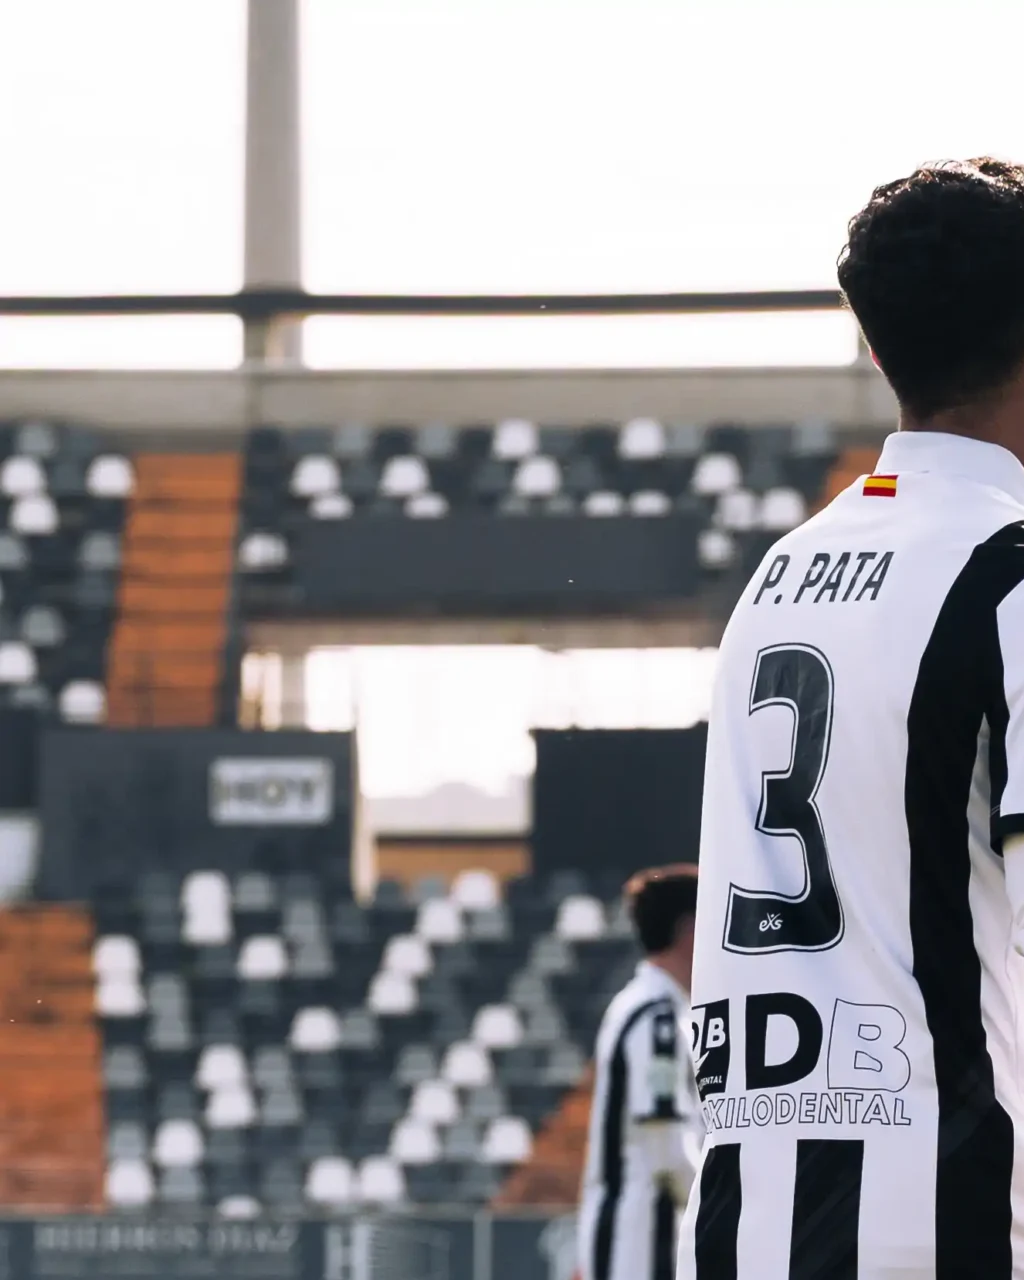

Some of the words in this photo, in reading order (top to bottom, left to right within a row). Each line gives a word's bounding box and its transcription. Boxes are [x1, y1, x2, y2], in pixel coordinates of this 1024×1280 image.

[753, 554, 790, 605] P.
[793, 551, 895, 604] PATA
[722, 642, 846, 955] 3
[703, 1092, 911, 1134] XILODENTAL
